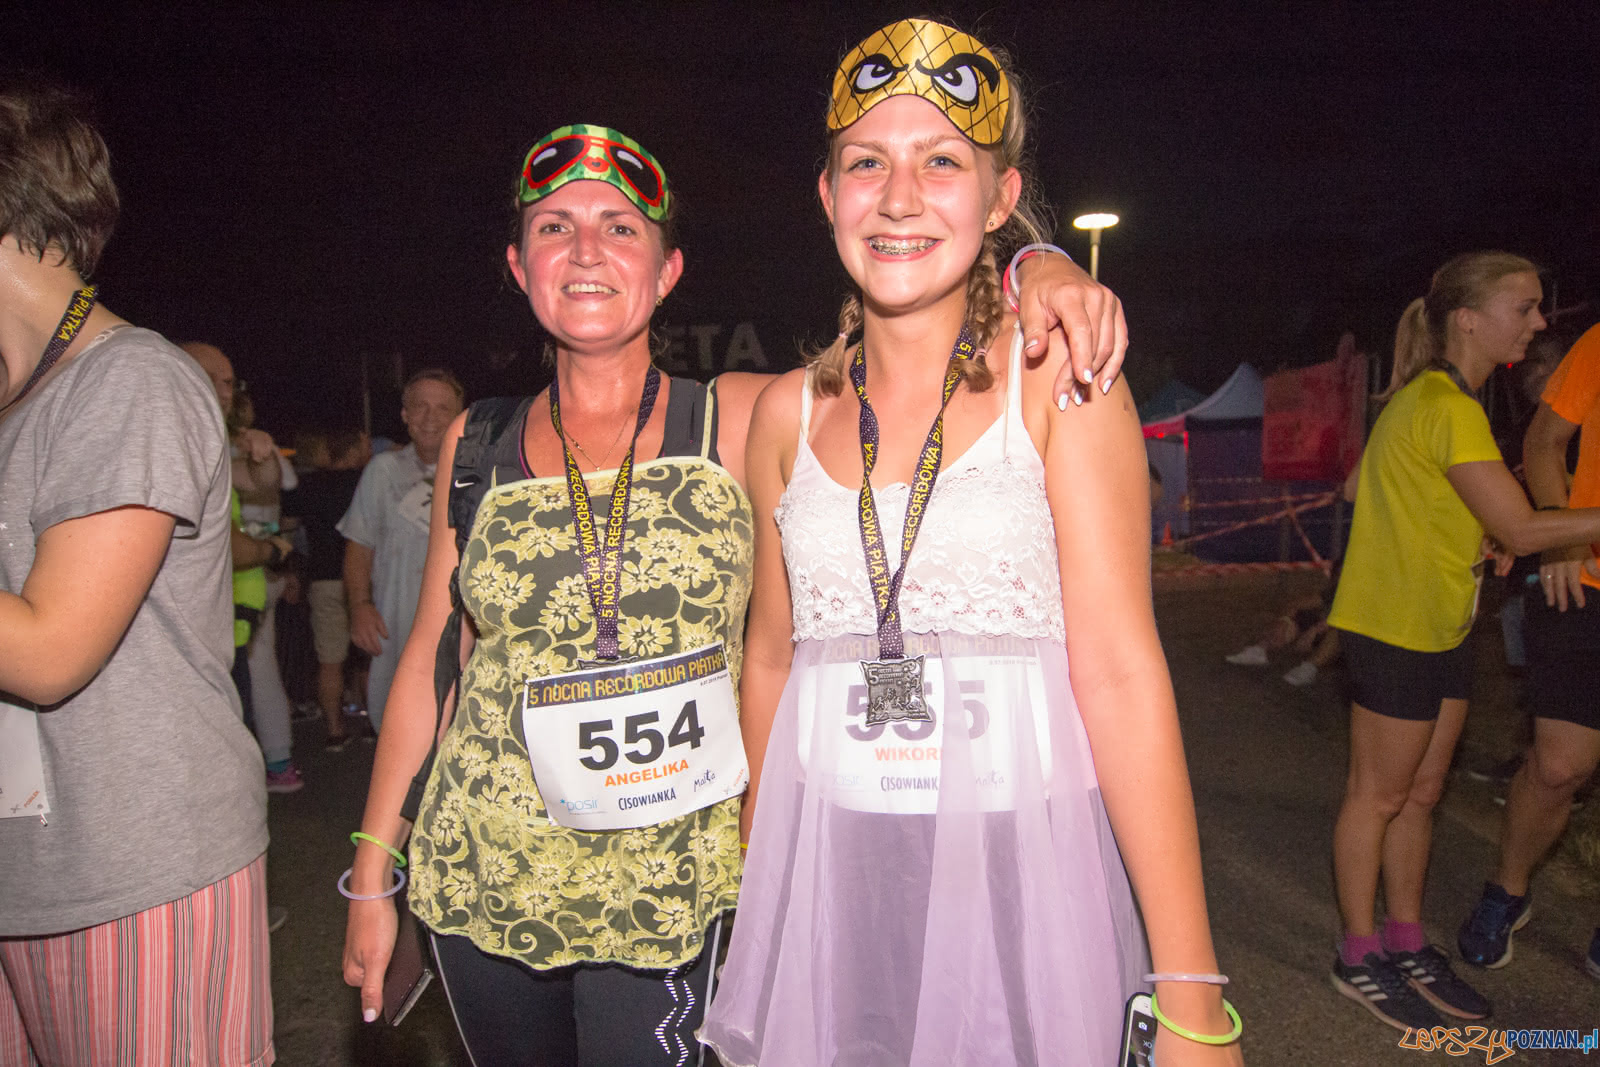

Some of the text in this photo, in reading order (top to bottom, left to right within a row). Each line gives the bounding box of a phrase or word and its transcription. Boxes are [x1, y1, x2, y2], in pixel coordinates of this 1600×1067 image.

[667, 322, 769, 371] ETA
[960, 342, 972, 353] 5
[569, 466, 596, 555] RECORDOWA
[905, 447, 941, 550] RECORDOWA
[602, 457, 632, 617] 5 NOCNA RECORDOWA
[529, 687, 539, 705] 5
[579, 700, 705, 771] 554
[874, 747, 945, 761] WIKORI
[604, 760, 689, 787] ANGELIKA
[880, 775, 938, 792] CISOWIANK
[618, 787, 677, 811] CISOWIANKA
